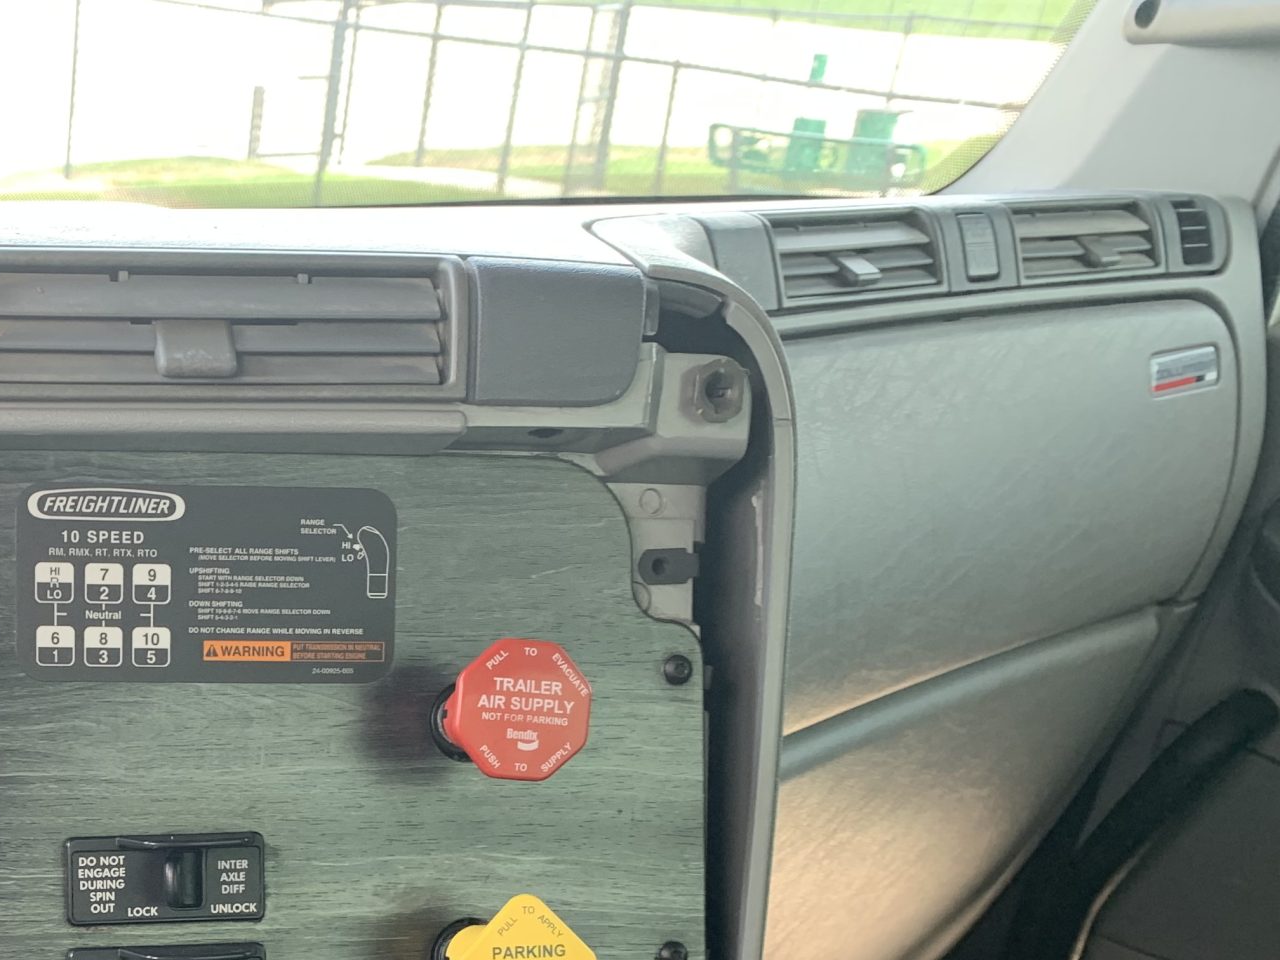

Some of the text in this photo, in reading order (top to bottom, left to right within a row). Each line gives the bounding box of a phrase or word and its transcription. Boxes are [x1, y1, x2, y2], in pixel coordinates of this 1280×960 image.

[43, 496, 170, 514] FREIGHTLINER
[300, 518, 325, 526] RANGE
[61, 530, 145, 544] 10 SPEED
[300, 527, 337, 535] SELECTOR
[341, 554, 354, 562] LO
[50, 567, 60, 576] HI
[100, 568, 109, 581] 7
[148, 569, 157, 581] 9
[47, 590, 62, 599] LO
[99, 587, 109, 600] 2
[147, 587, 156, 600] 4
[85, 610, 122, 619] Neutral
[51, 632, 60, 645] 6
[99, 632, 108, 645] 8
[143, 633, 160, 645] 10
[99, 650, 108, 664] 3
[147, 651, 156, 664] 5
[220, 646, 285, 657] WARNING
[486, 647, 589, 697] PULL TO EVACUATE
[494, 677, 562, 695] TRAILER
[477, 695, 575, 714] AIR SUPPLY
[482, 712, 568, 726] NOT FOR PARKING
[507, 728, 538, 740] Bendix
[480, 742, 572, 773] PUSH TO SUPPLY
[78, 856, 125, 867] DO NOT
[217, 860, 248, 869] INTER
[78, 867, 126, 879] ENGAGE
[220, 872, 246, 882] AXLE
[79, 879, 125, 891] DURING
[221, 884, 246, 894] DIFF
[90, 892, 115, 902] SPIN
[91, 903, 115, 914] OUT
[127, 907, 158, 917] LOCK
[210, 903, 257, 914] UNLOCK
[498, 906, 563, 938] PULL TO APPLY
[492, 944, 566, 960] PARKING
